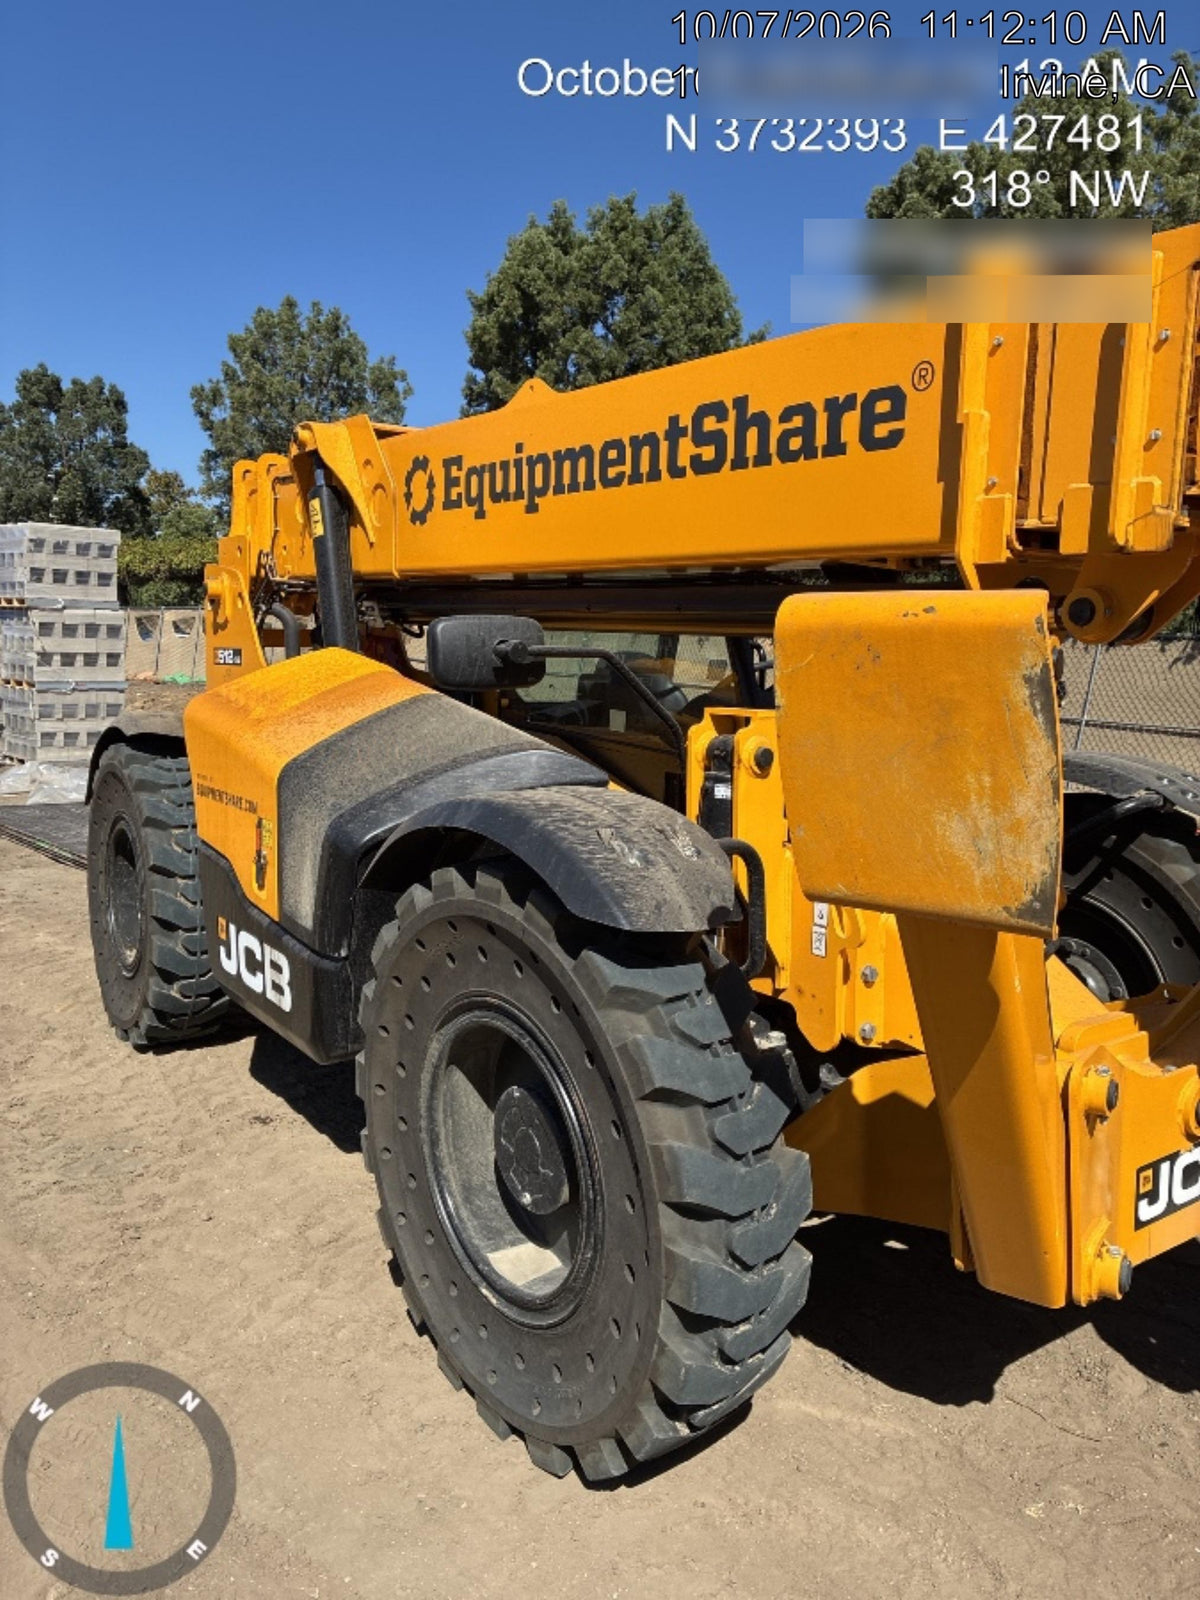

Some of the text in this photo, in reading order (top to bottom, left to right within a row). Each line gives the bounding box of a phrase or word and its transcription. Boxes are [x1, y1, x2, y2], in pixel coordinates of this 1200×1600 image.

[442, 384, 908, 520] EquipmentShare
[220, 921, 292, 1012] JCB
[1138, 1146, 1200, 1222] JC
